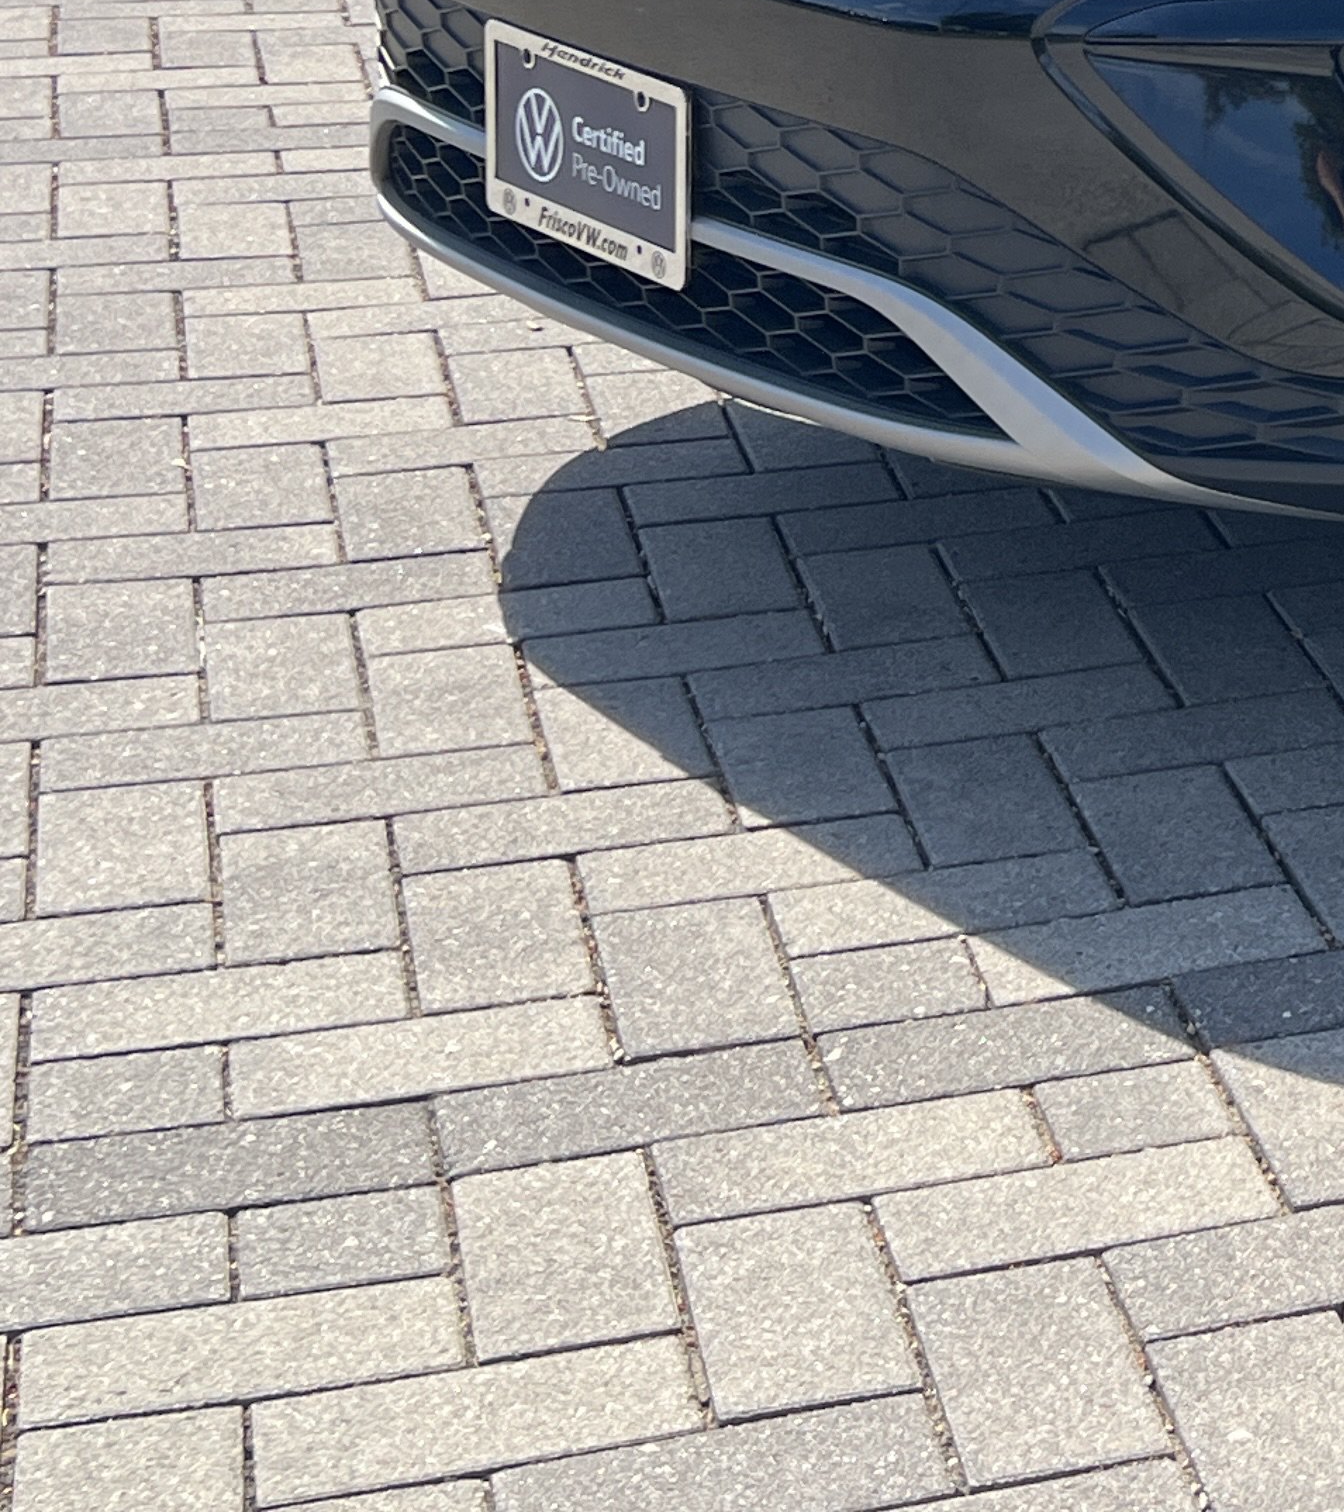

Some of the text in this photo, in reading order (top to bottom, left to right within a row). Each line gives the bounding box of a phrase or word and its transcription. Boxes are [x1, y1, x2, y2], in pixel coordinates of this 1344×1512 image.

[541, 42, 626, 80] Hendrick
[515, 88, 564, 183] VW
[572, 116, 646, 166] Certified
[572, 152, 662, 210] Pre-Owned
[538, 206, 629, 261] FriscoVW.com
